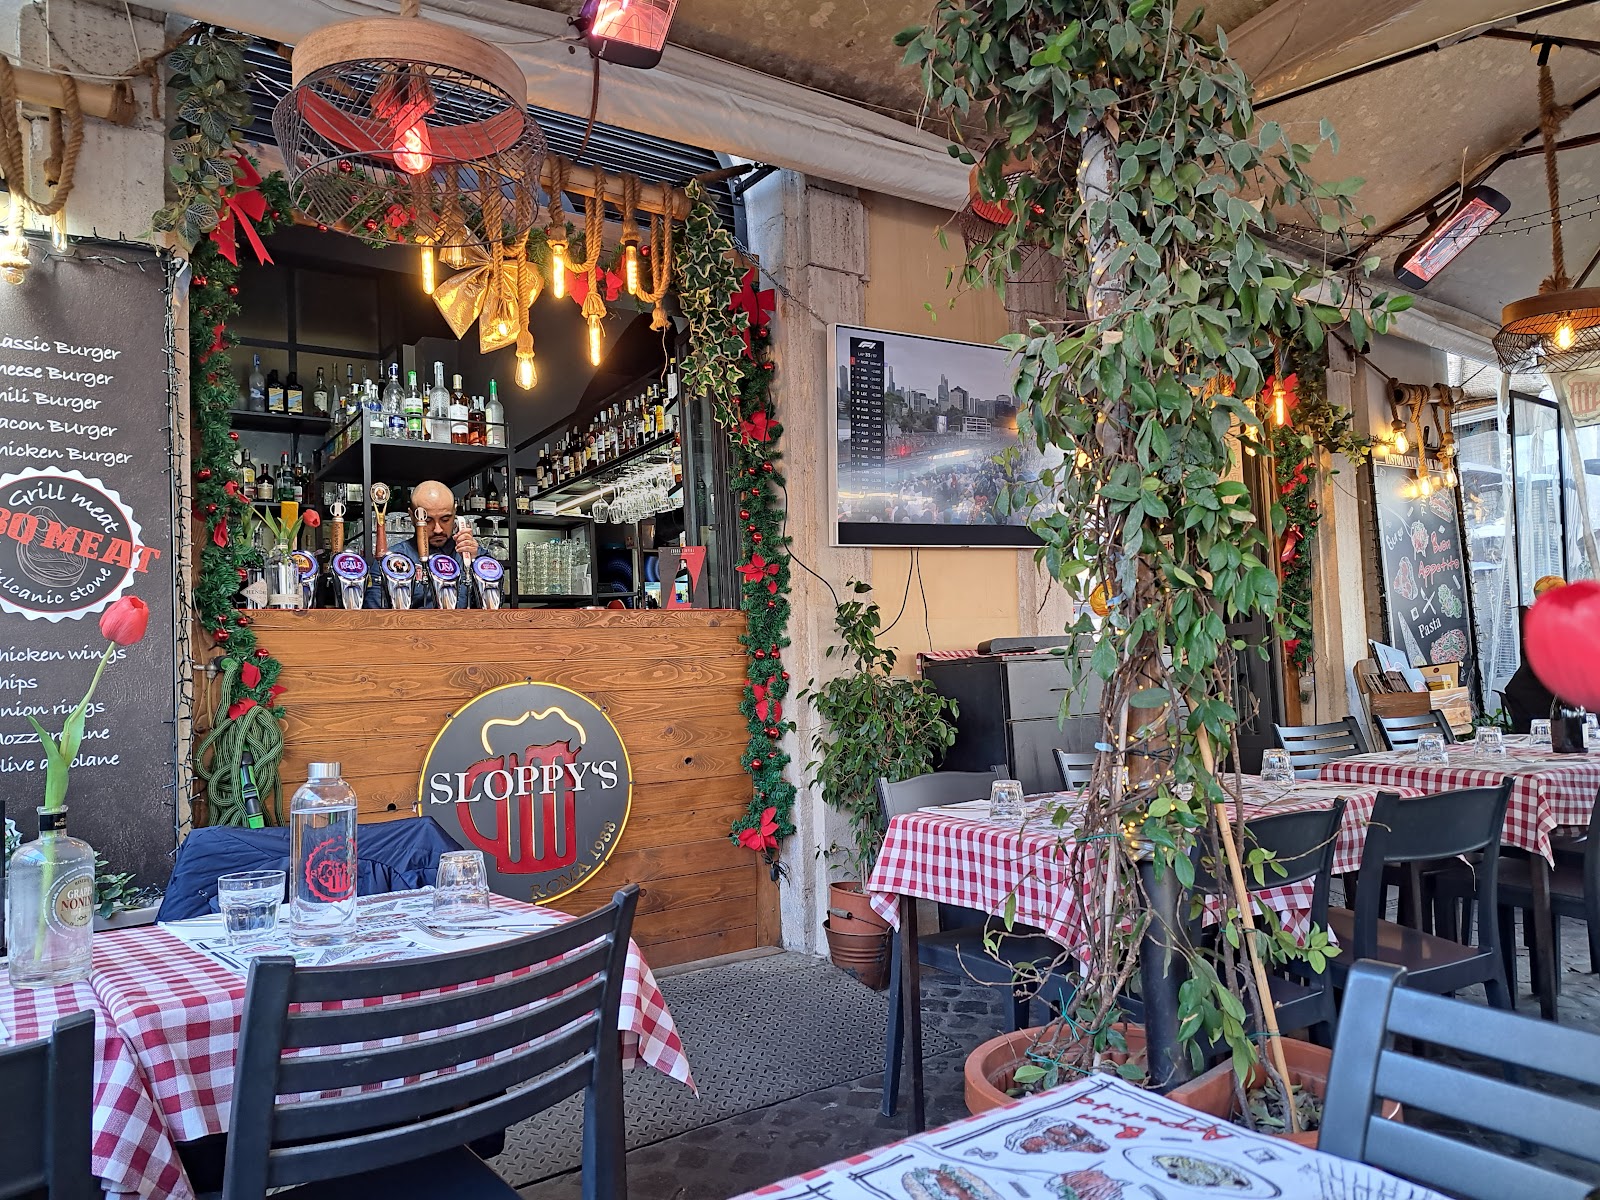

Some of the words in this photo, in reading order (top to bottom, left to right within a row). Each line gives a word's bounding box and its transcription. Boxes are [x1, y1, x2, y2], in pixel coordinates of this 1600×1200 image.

[0, 333, 51, 352] assic
[53, 341, 121, 362] Burger
[46, 366, 114, 388] Burger
[33, 391, 102, 412] Burger
[0, 417, 44, 430] acon
[47, 419, 118, 440] Burger
[66, 447, 133, 467] Burger
[9, 481, 66, 507] Grill
[71, 492, 118, 534] meat
[0, 507, 39, 545] BO
[40, 520, 161, 574] MEAT
[1430, 531, 1451, 554] Buon
[340, 561, 363, 570] REALE
[438, 561, 455, 572] USA
[1418, 555, 1460, 589] Appetito
[0, 569, 65, 604] lcanic
[70, 567, 111, 602] stone
[1418, 618, 1442, 639] Pasta
[0, 646, 64, 662] hicken
[0, 674, 38, 695] hips
[0, 700, 48, 717] nion
[0, 756, 35, 772] live
[39, 753, 120, 770] aolane
[430, 760, 618, 805] SLOPPY'S
[530, 861, 592, 900] ROMA
[590, 821, 616, 861] 1988
[61, 895, 93, 912] NONIN
[67, 886, 93, 900] GRAPP
[1075, 1094, 1234, 1141] Appetito
[1076, 1113, 1147, 1140] Buon
